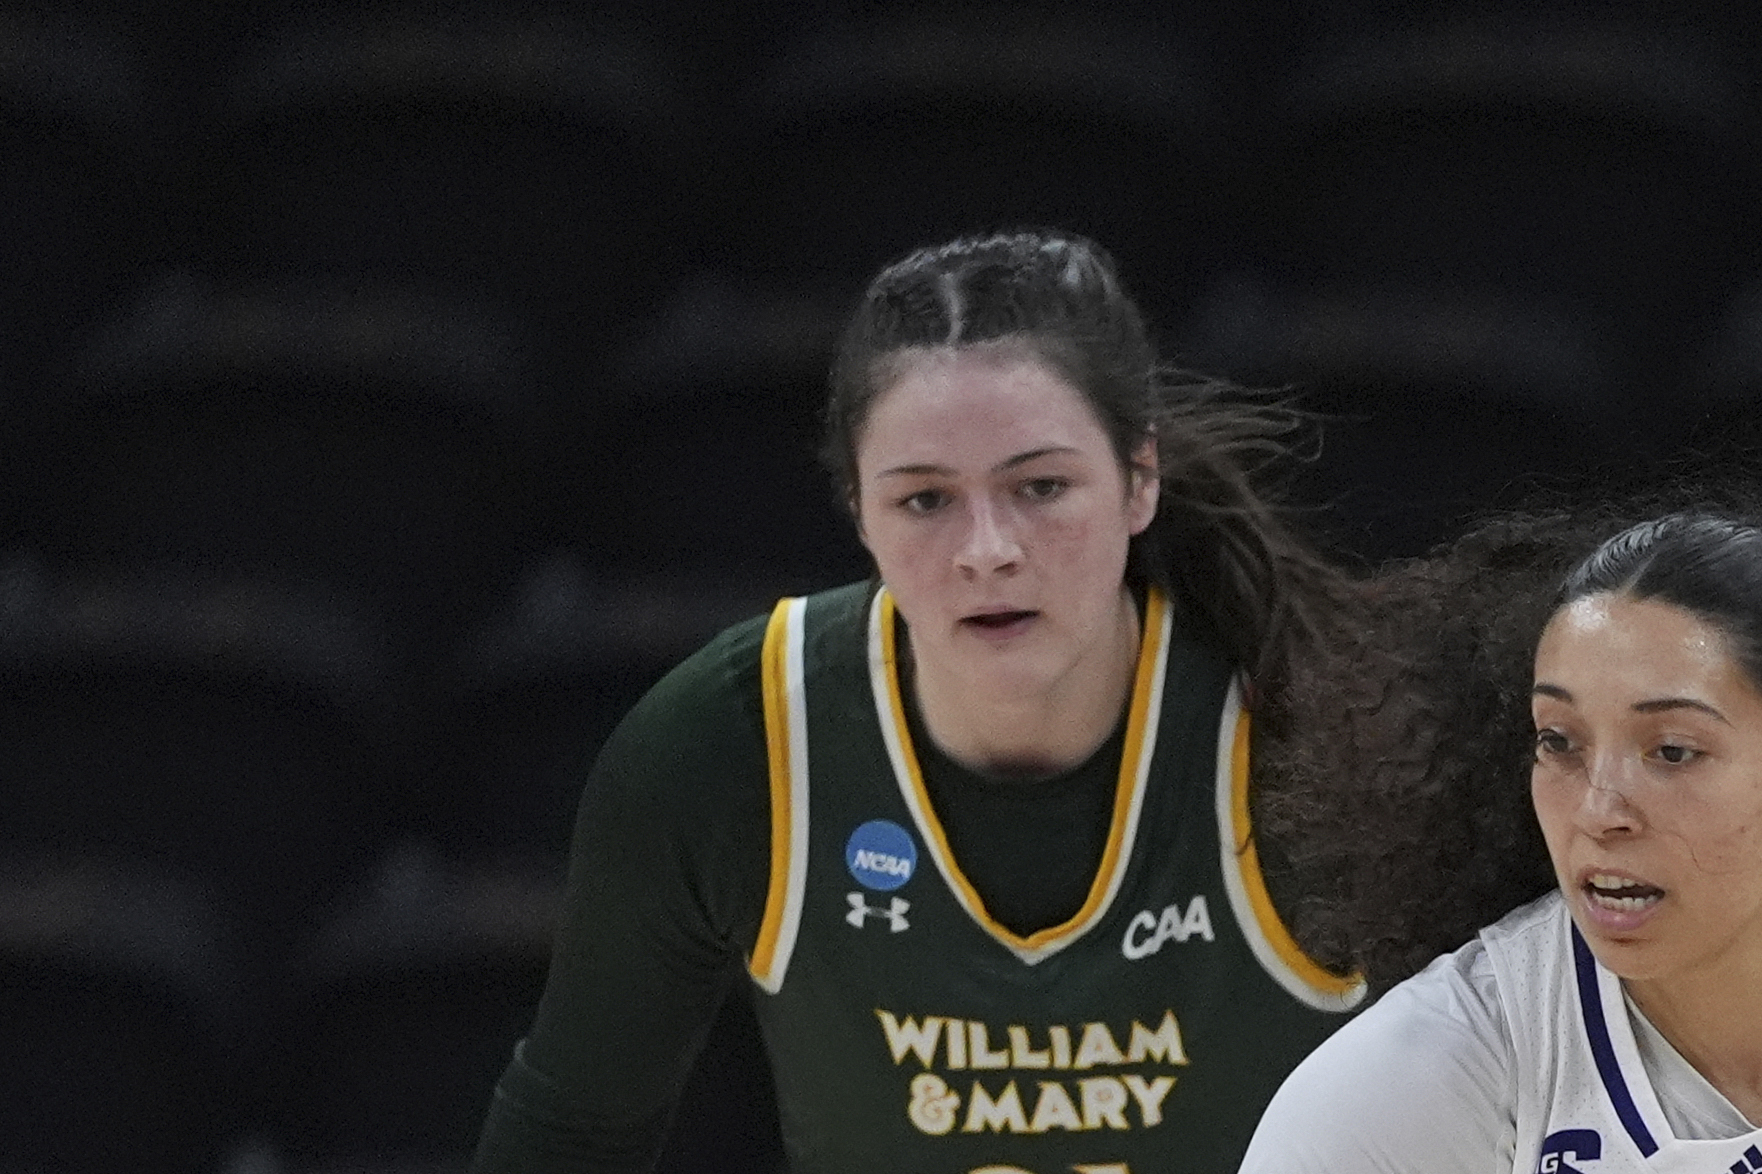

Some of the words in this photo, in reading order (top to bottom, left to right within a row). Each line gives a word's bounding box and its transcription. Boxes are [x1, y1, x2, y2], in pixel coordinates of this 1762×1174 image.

[854, 849, 911, 879] NCAA
[1122, 895, 1215, 960] CAA
[875, 1008, 1190, 1070] WILLIAM
[908, 1072, 1178, 1136] &MARY
